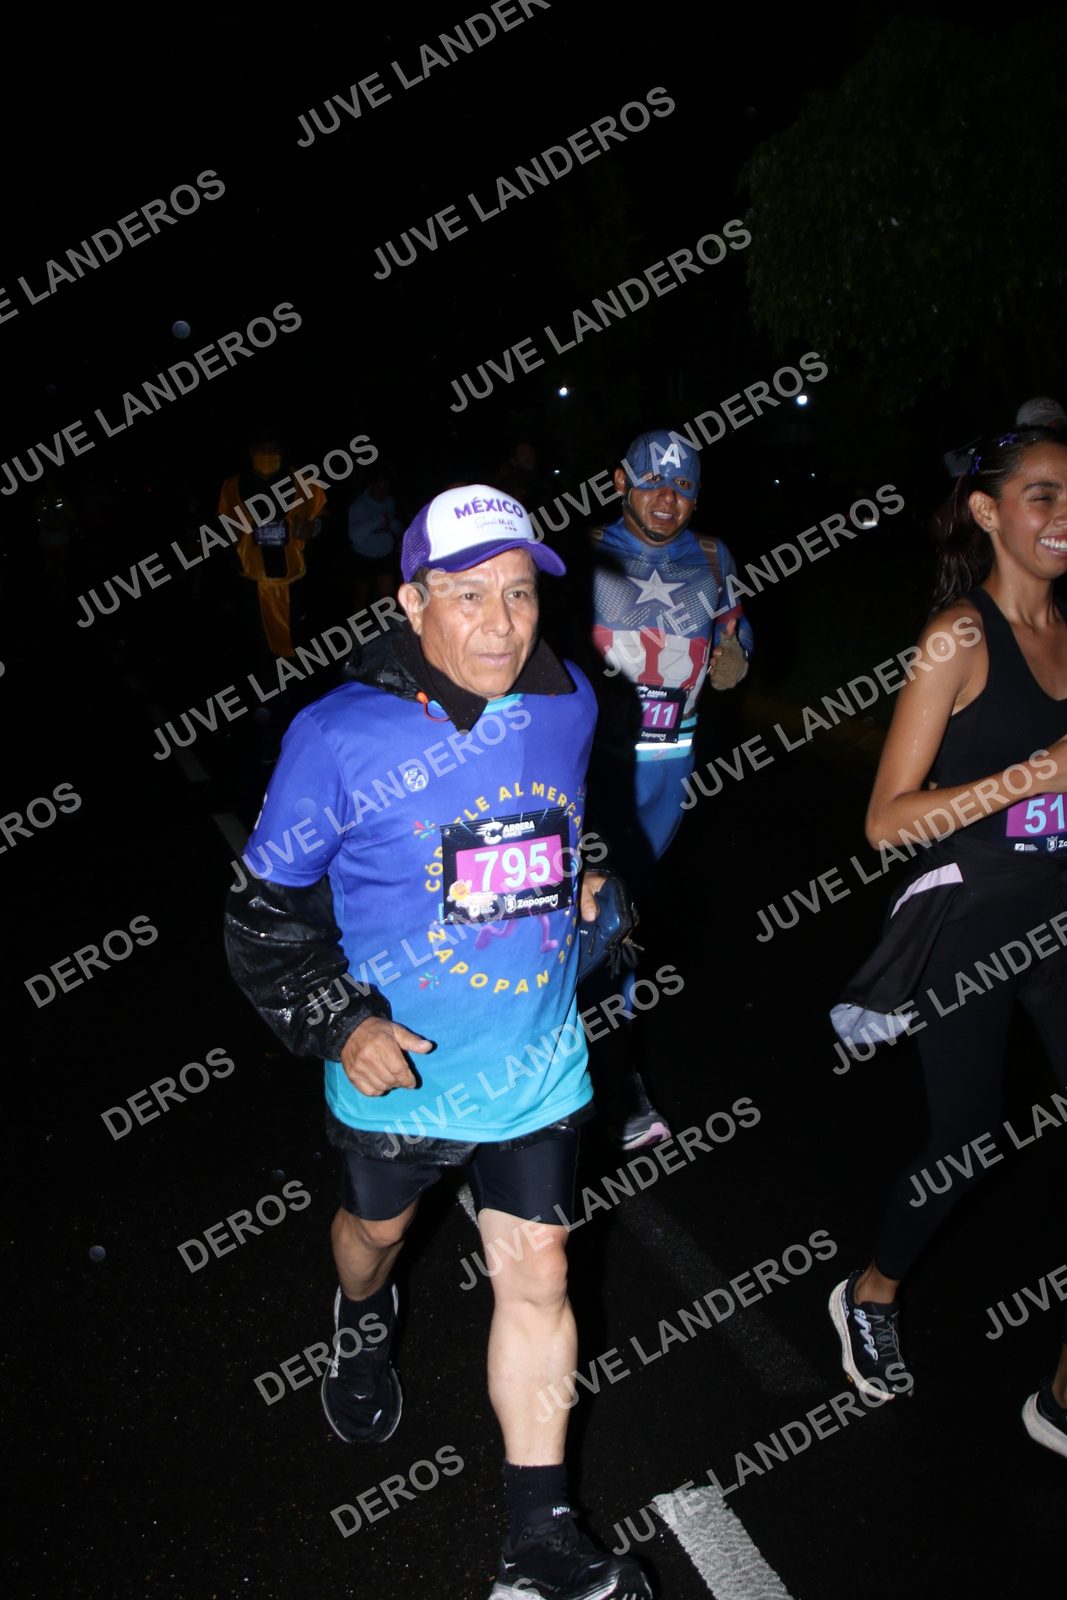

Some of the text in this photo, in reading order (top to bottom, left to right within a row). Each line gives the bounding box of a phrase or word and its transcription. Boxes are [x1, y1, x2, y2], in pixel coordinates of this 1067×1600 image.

[453, 497, 524, 519] MÉXICO
[499, 782, 525, 802] AL
[475, 842, 551, 892] 795
[516, 893, 559, 909] Zapopan
[427, 927, 550, 995] ZAPOPAN
